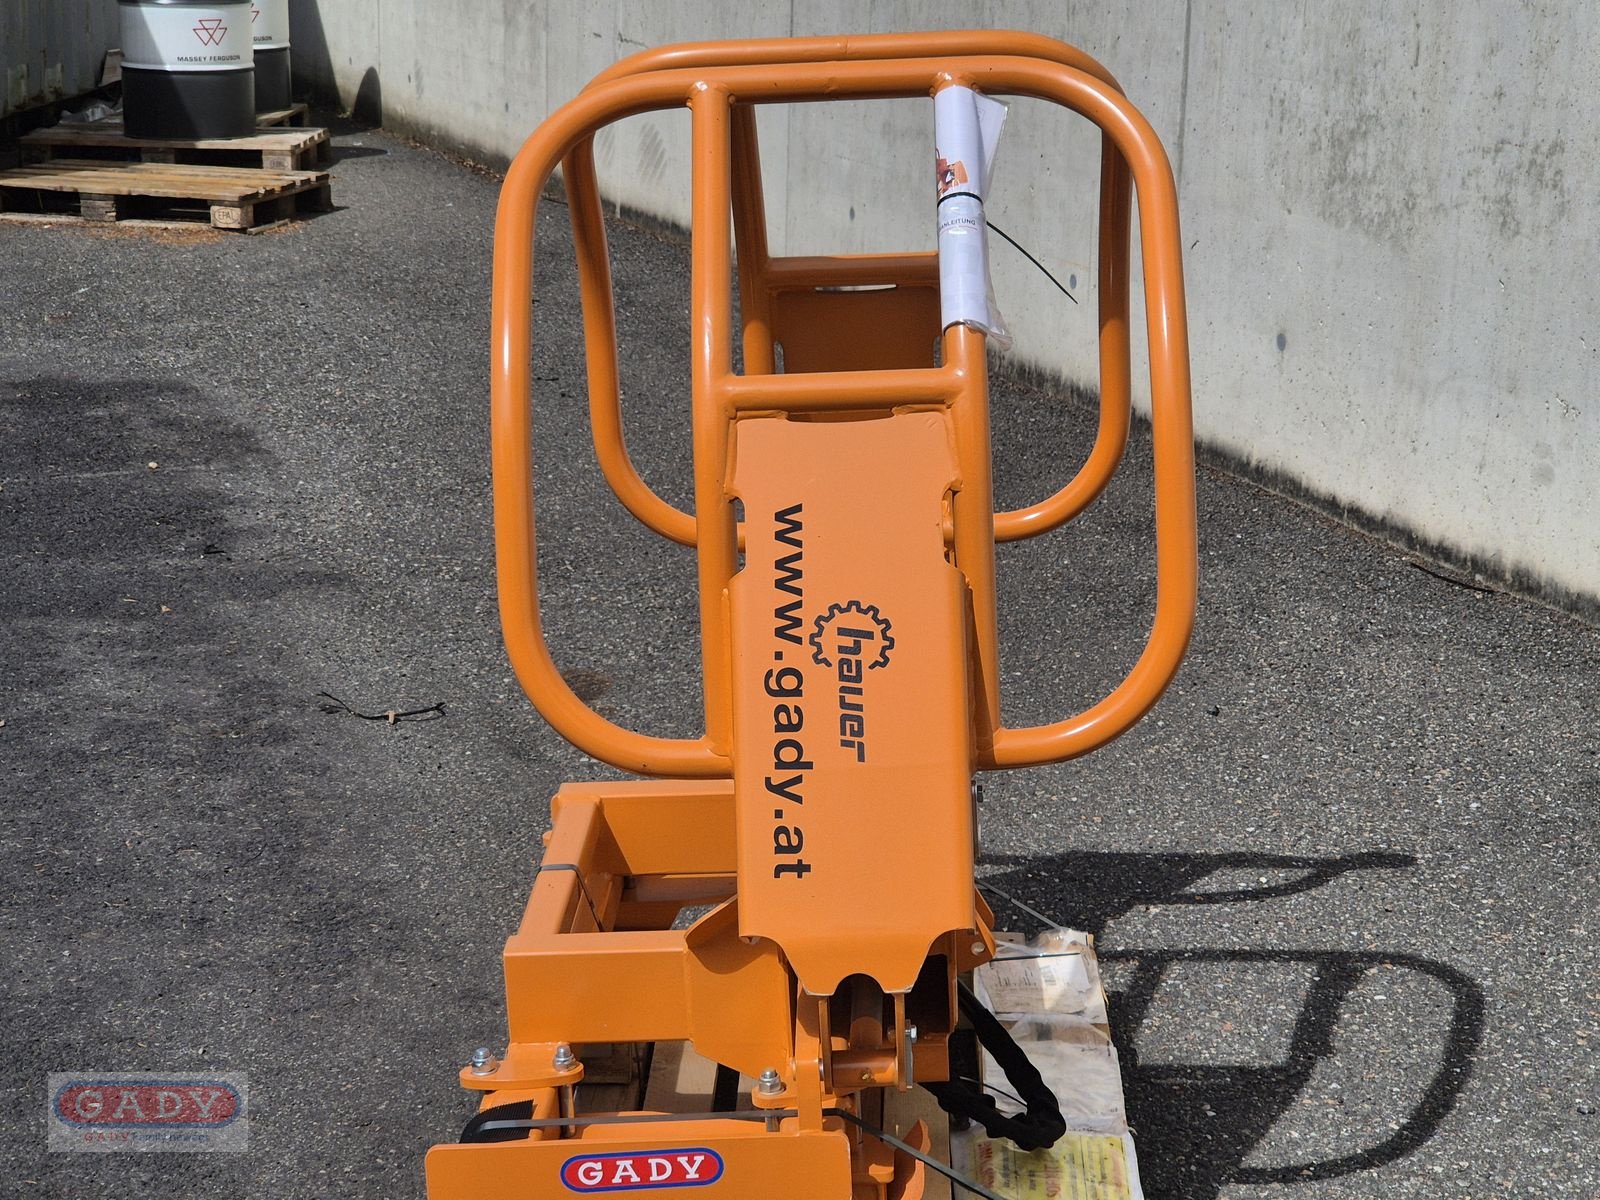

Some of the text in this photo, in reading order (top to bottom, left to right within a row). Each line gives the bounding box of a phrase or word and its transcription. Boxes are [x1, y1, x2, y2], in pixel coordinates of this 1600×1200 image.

[209, 54, 241, 62] FERGUSON
[217, 210, 238, 221] EPAL
[939, 217, 976, 230] ANLEITUNG
[764, 502, 813, 880] www.gady.at
[837, 626, 875, 763] hauer
[577, 1154, 705, 1187] GADY
